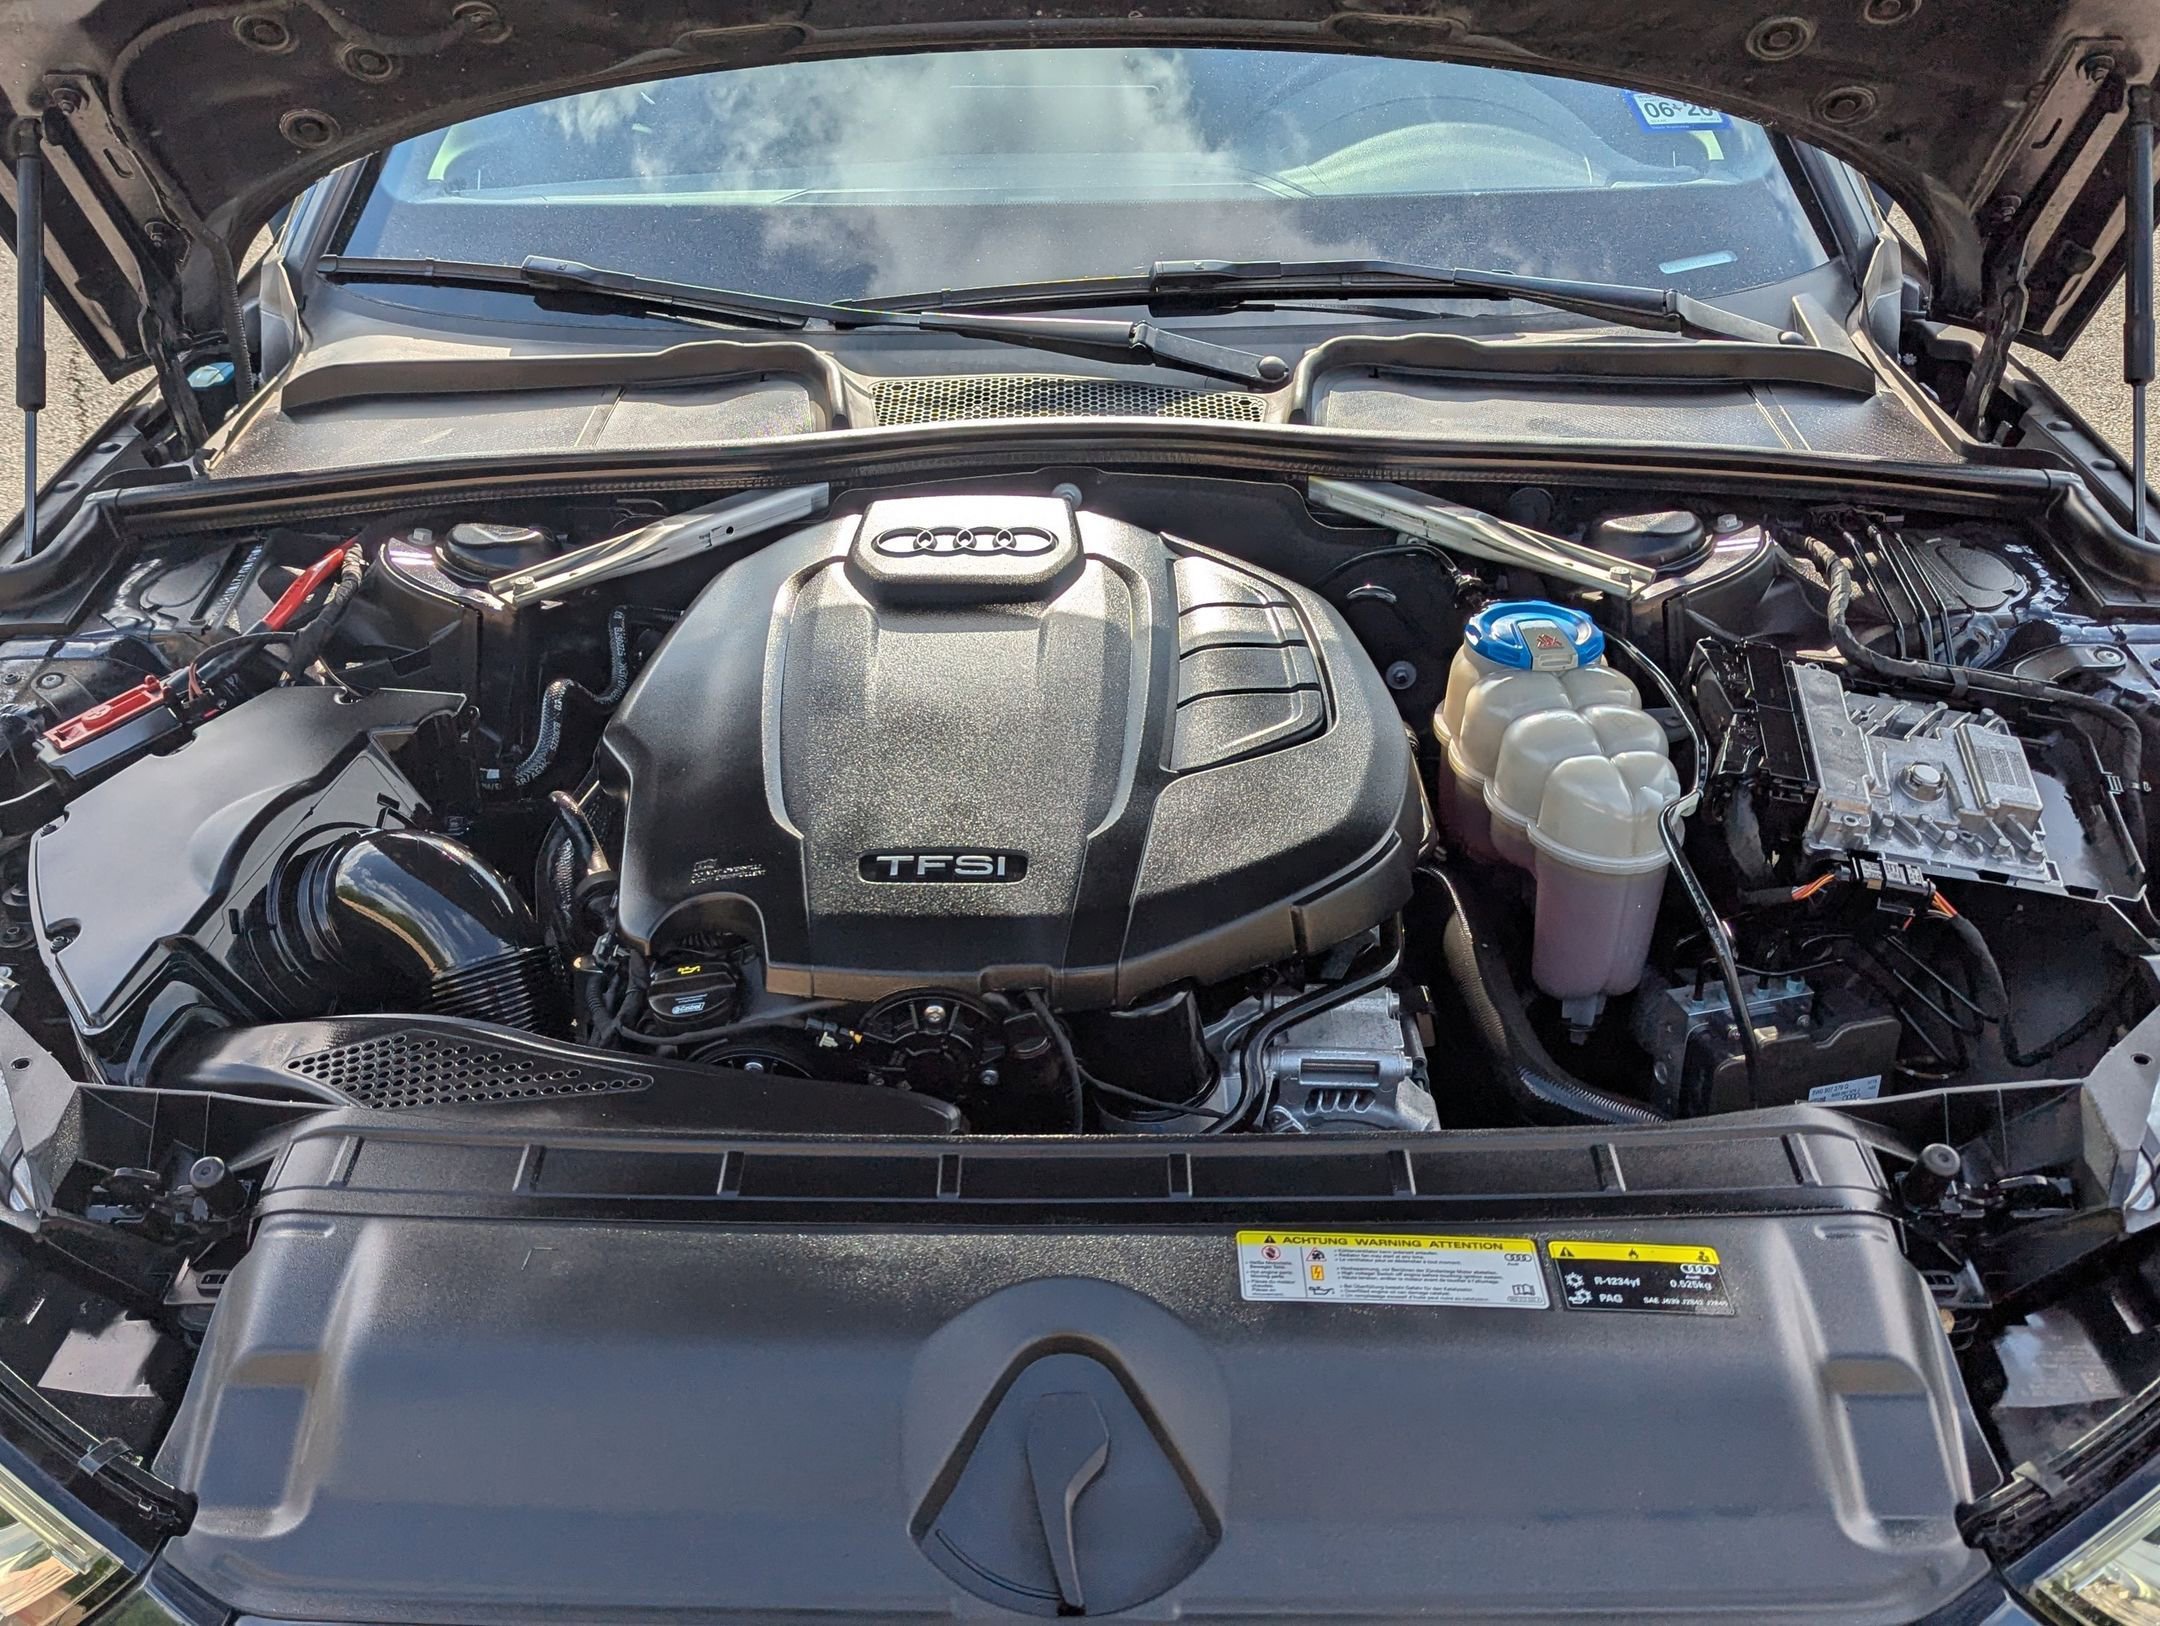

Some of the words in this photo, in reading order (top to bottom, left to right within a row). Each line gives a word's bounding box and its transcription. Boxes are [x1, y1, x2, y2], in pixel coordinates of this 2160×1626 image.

[1643, 101, 1675, 118] 06
[876, 855, 1006, 876] TFSI
[1282, 1236, 1349, 1245] ACHTUNG
[1354, 1238, 1422, 1247] WARNING
[1429, 1240, 1504, 1250] ATTENTION
[1599, 1294, 1624, 1303] PAG
